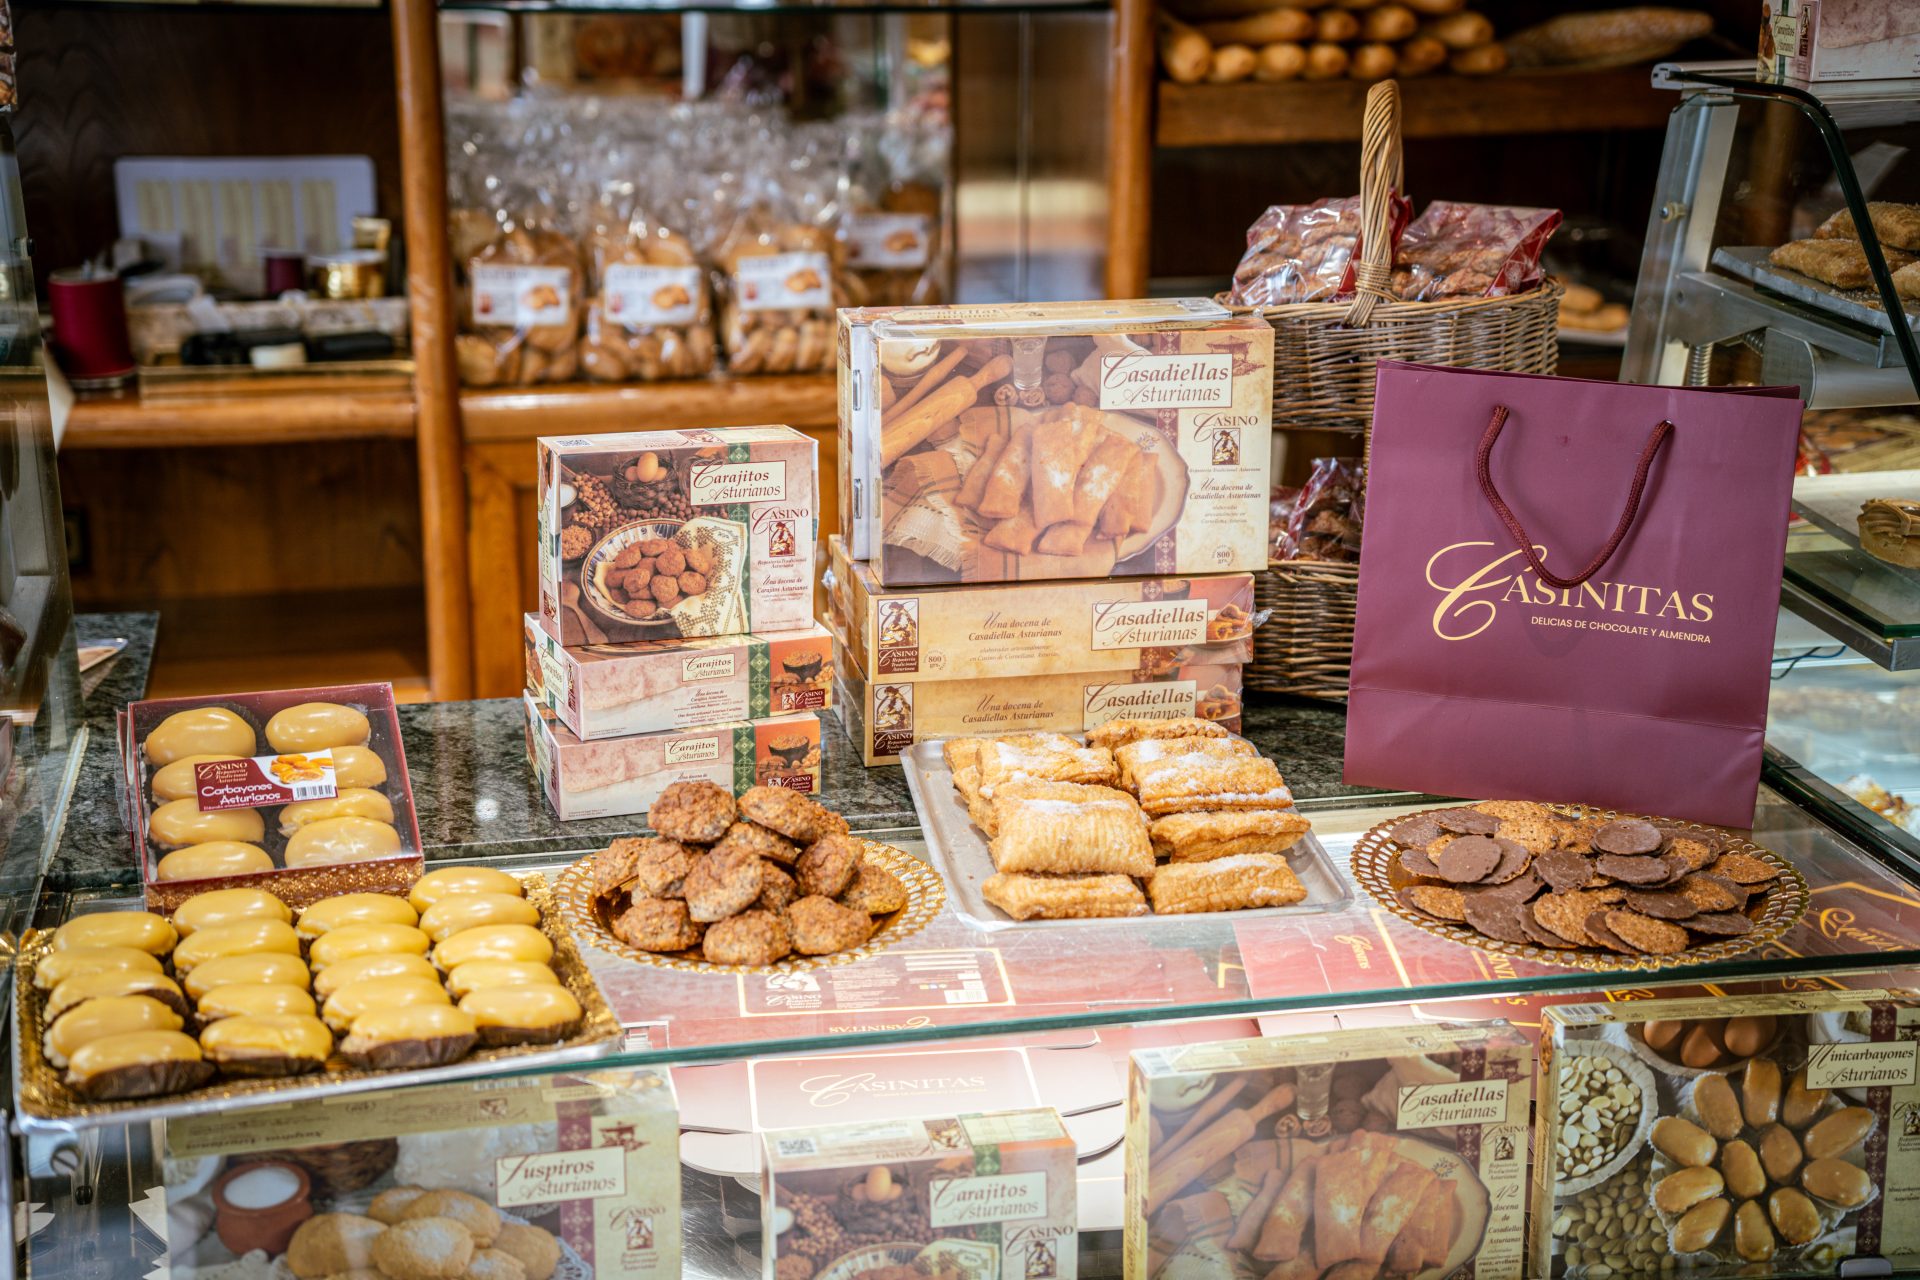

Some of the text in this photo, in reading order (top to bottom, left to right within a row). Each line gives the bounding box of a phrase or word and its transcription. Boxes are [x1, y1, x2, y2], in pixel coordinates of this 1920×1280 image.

[1103, 350, 1228, 389] Casadiellas
[1112, 384, 1221, 407] Asturianas
[1193, 413, 1258, 442] CASINO
[691, 459, 769, 489] Carajitos
[701, 484, 781, 503] Asturianos
[1189, 491, 1261, 500] Casadiellas Asturianas
[752, 506, 809, 536] CASINO
[1426, 541, 1715, 641] CASINITAS
[983, 611, 1051, 630] Una docena de
[1094, 598, 1204, 631] Casadiellas
[968, 629, 1062, 641] Casadiellas Asturianas
[1102, 626, 1198, 646] Asturianas
[1530, 616, 1712, 644] DELICIAS DE CHOCOLATE Y ALMENDRA
[685, 655, 732, 672] Carajitos
[878, 649, 918, 667] CASINO
[795, 688, 823, 705] CASINO
[976, 694, 1043, 712] Una docena de
[1086, 680, 1193, 713] Casadiellas
[962, 711, 1054, 724] Casadiellas Asturianas
[669, 739, 716, 755] Carajitos
[874, 731, 913, 749] CASINO
[198, 762, 248, 780] CASINO
[201, 783, 273, 797] Carbayones
[782, 775, 811, 788] CASINO
[220, 792, 281, 805] Asturianos
[1787, 1039, 1914, 1072] Minicarbayones
[1816, 1066, 1908, 1087] Asturianos
[799, 1072, 985, 1107] CASINITAS
[1400, 1084, 1505, 1113] Casadiellas
[1406, 1105, 1498, 1126] Asturianas
[1482, 1125, 1529, 1145] CASINO
[500, 1153, 595, 1188] Suspiros
[508, 1176, 616, 1202] Asturianos
[932, 1172, 1029, 1209] Carajitos
[1496, 1183, 1519, 1201] 1/2
[609, 1205, 666, 1231] CASINO
[942, 1202, 1040, 1222] Asturianos
[1488, 1225, 1522, 1234] Casadiellas
[1004, 1223, 1075, 1257] CASINO
